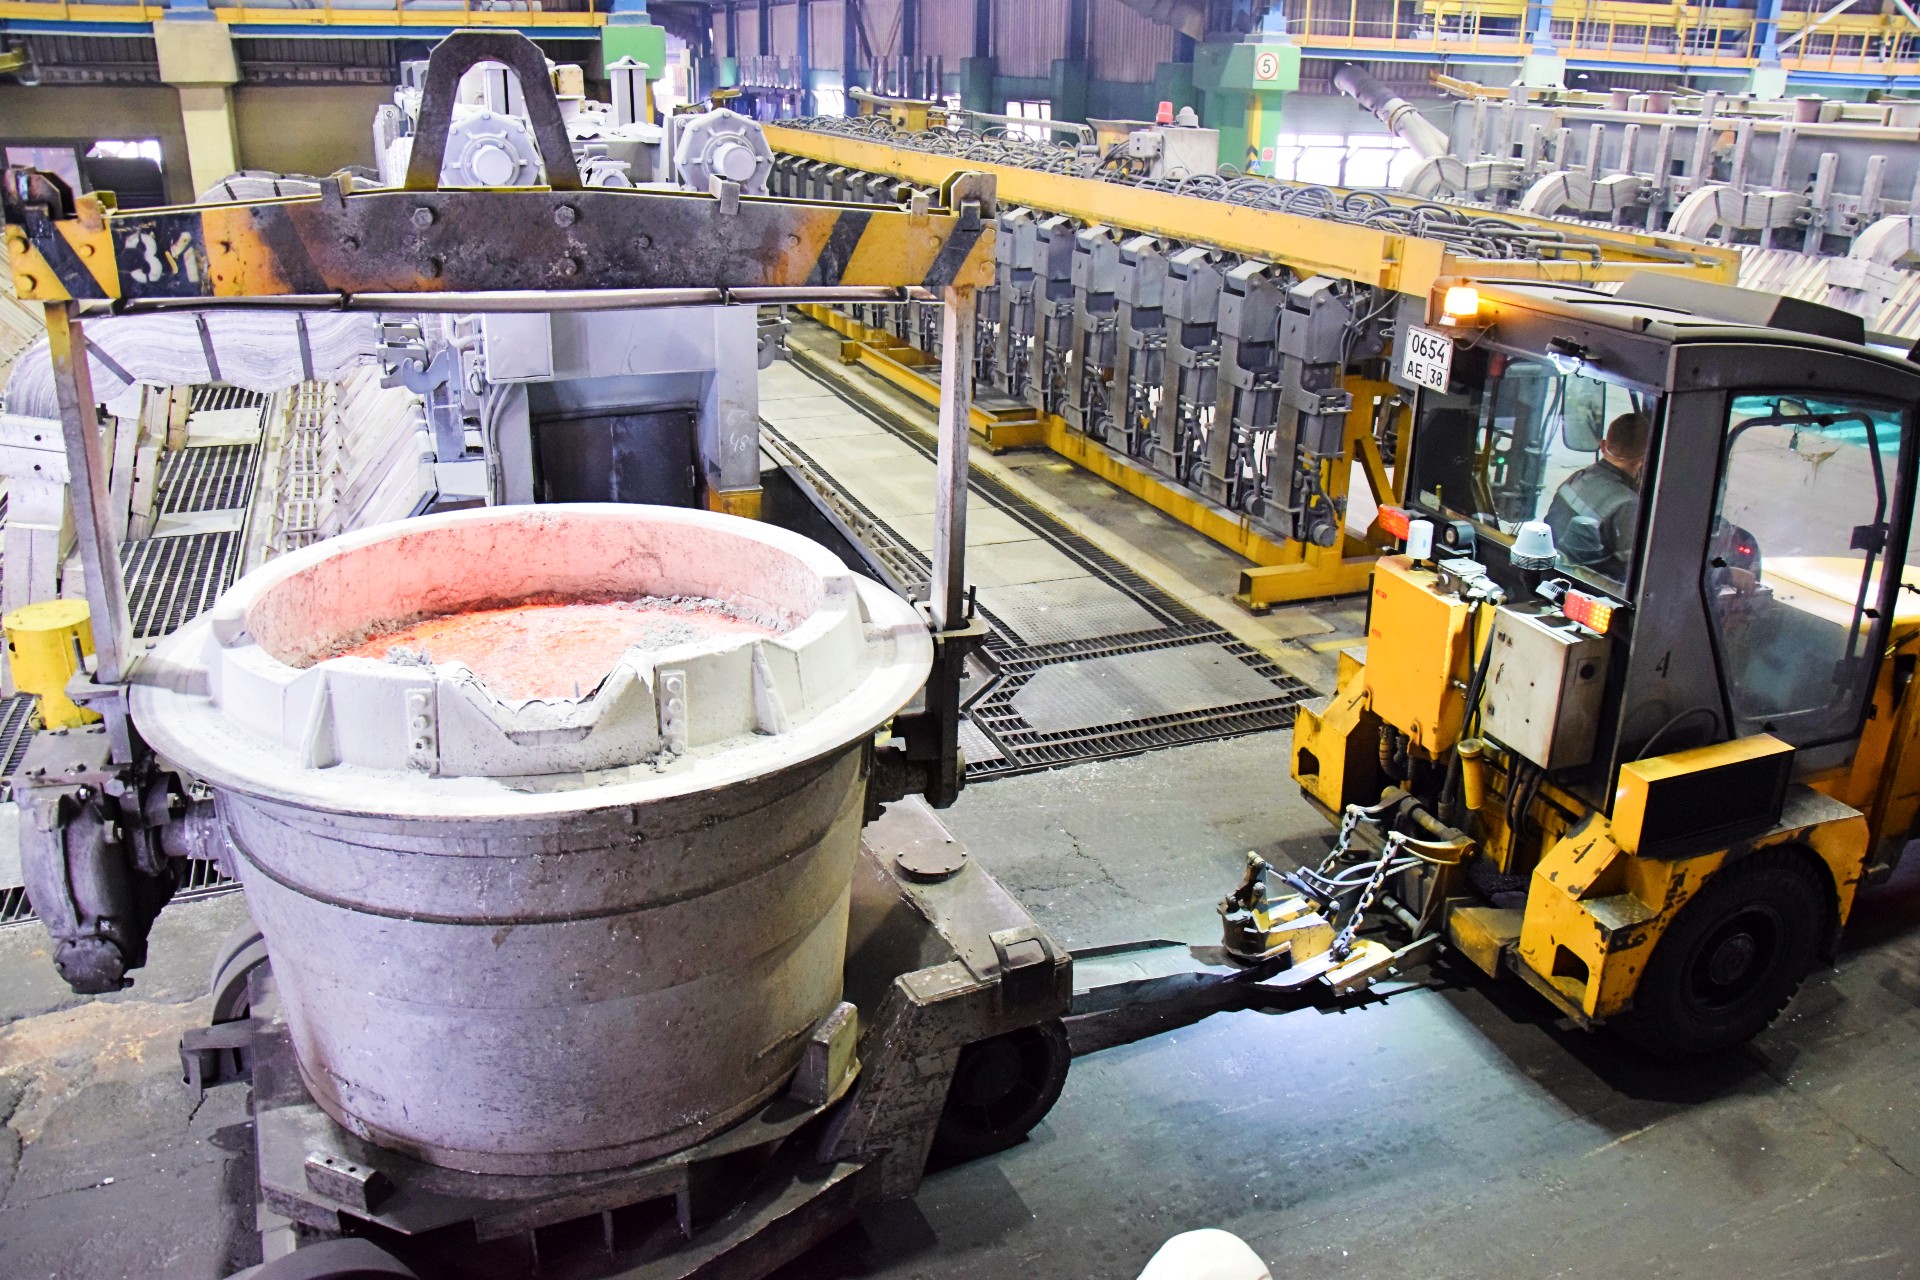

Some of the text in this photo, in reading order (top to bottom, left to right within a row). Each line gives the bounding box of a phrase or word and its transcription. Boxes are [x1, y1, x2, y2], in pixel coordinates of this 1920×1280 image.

[1262, 59, 1271, 74] 5
[124, 231, 200, 284] 31
[1412, 334, 1446, 364] 0654
[1406, 360, 1443, 387] AE 38
[730, 432, 750, 452] 48
[1655, 650, 1671, 678] 4
[1572, 838, 1597, 864] 4
